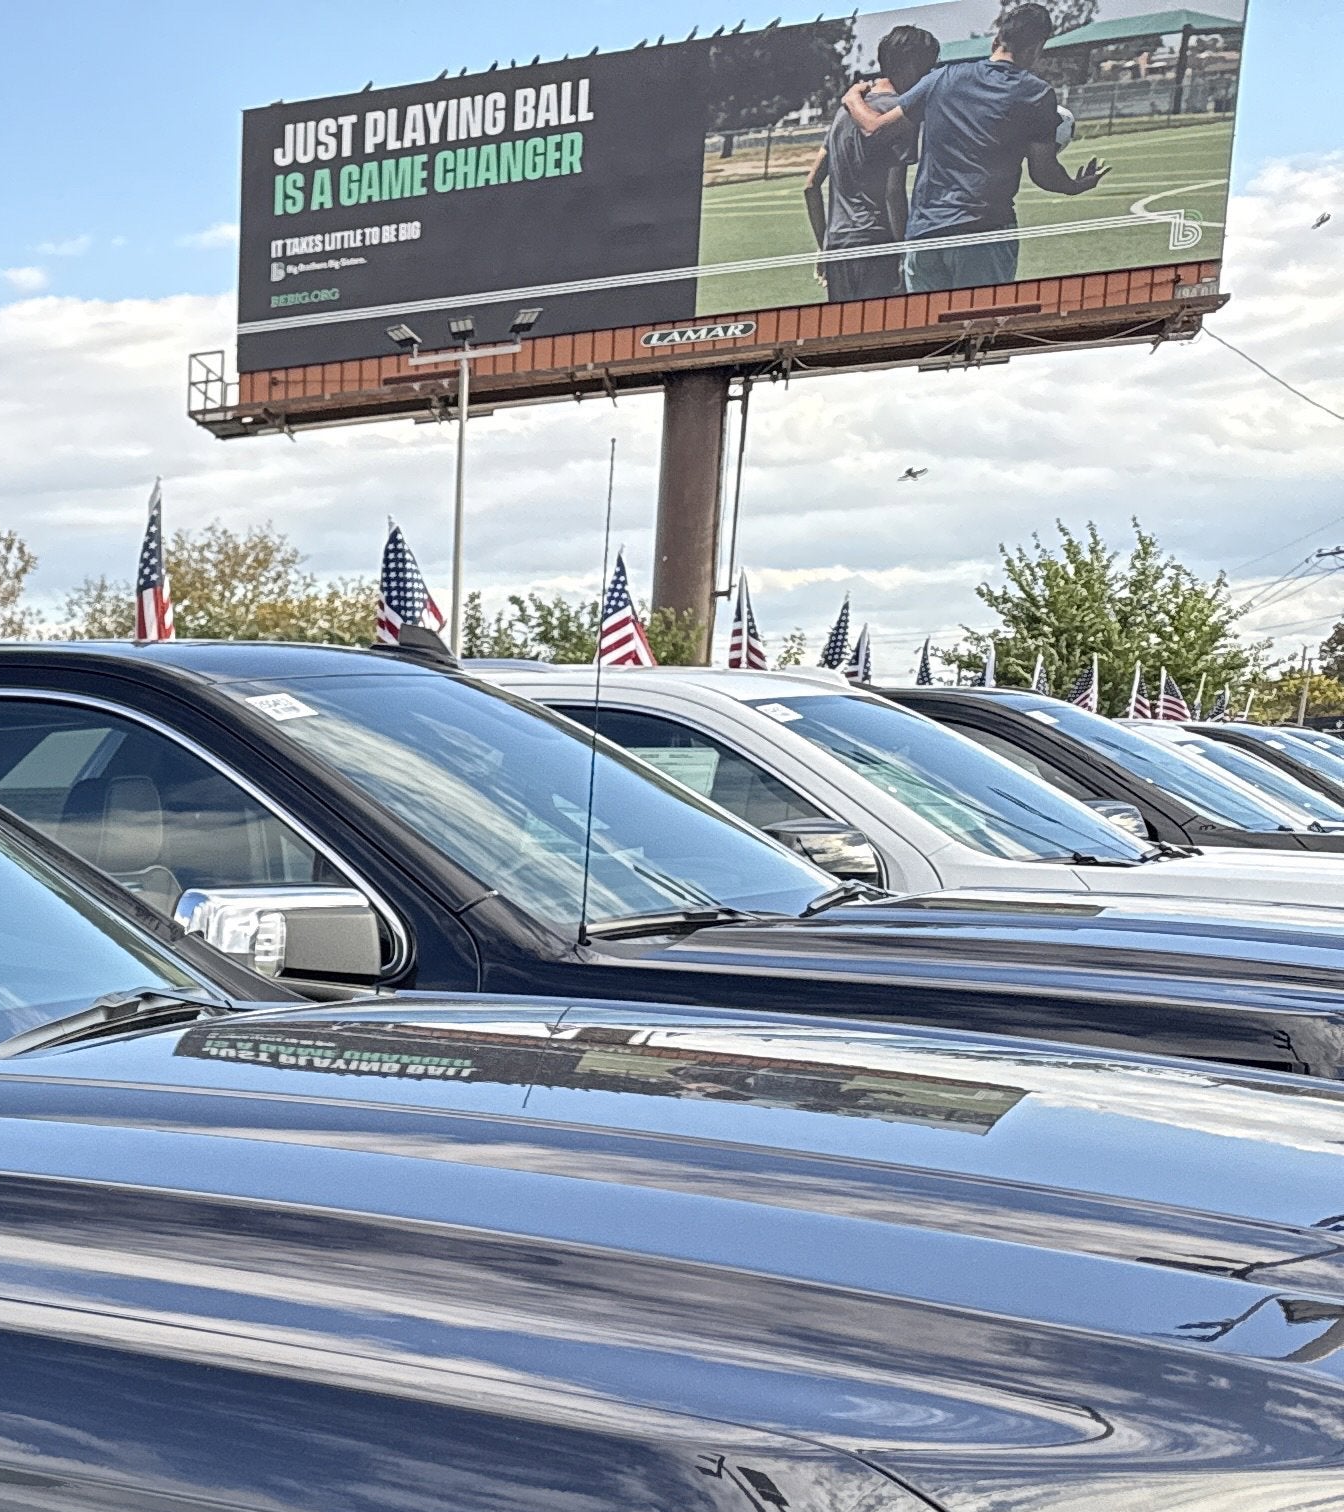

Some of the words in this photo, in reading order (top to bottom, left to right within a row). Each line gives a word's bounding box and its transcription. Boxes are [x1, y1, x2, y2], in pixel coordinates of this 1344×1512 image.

[273, 114, 357, 167] JUST
[364, 91, 506, 154] PLAYING
[513, 78, 594, 131] BALL
[273, 172, 305, 216] IS
[311, 168, 332, 211] A
[339, 153, 428, 207] GAME
[434, 131, 583, 193] CHANGER
[270, 240, 284, 259] IT
[286, 235, 323, 256] TAKES
[324, 229, 363, 251] LITTLE
[364, 226, 381, 246] TO
[381, 224, 398, 244] BE
[398, 221, 421, 241] BIG
[650, 324, 744, 344] LAMAR
